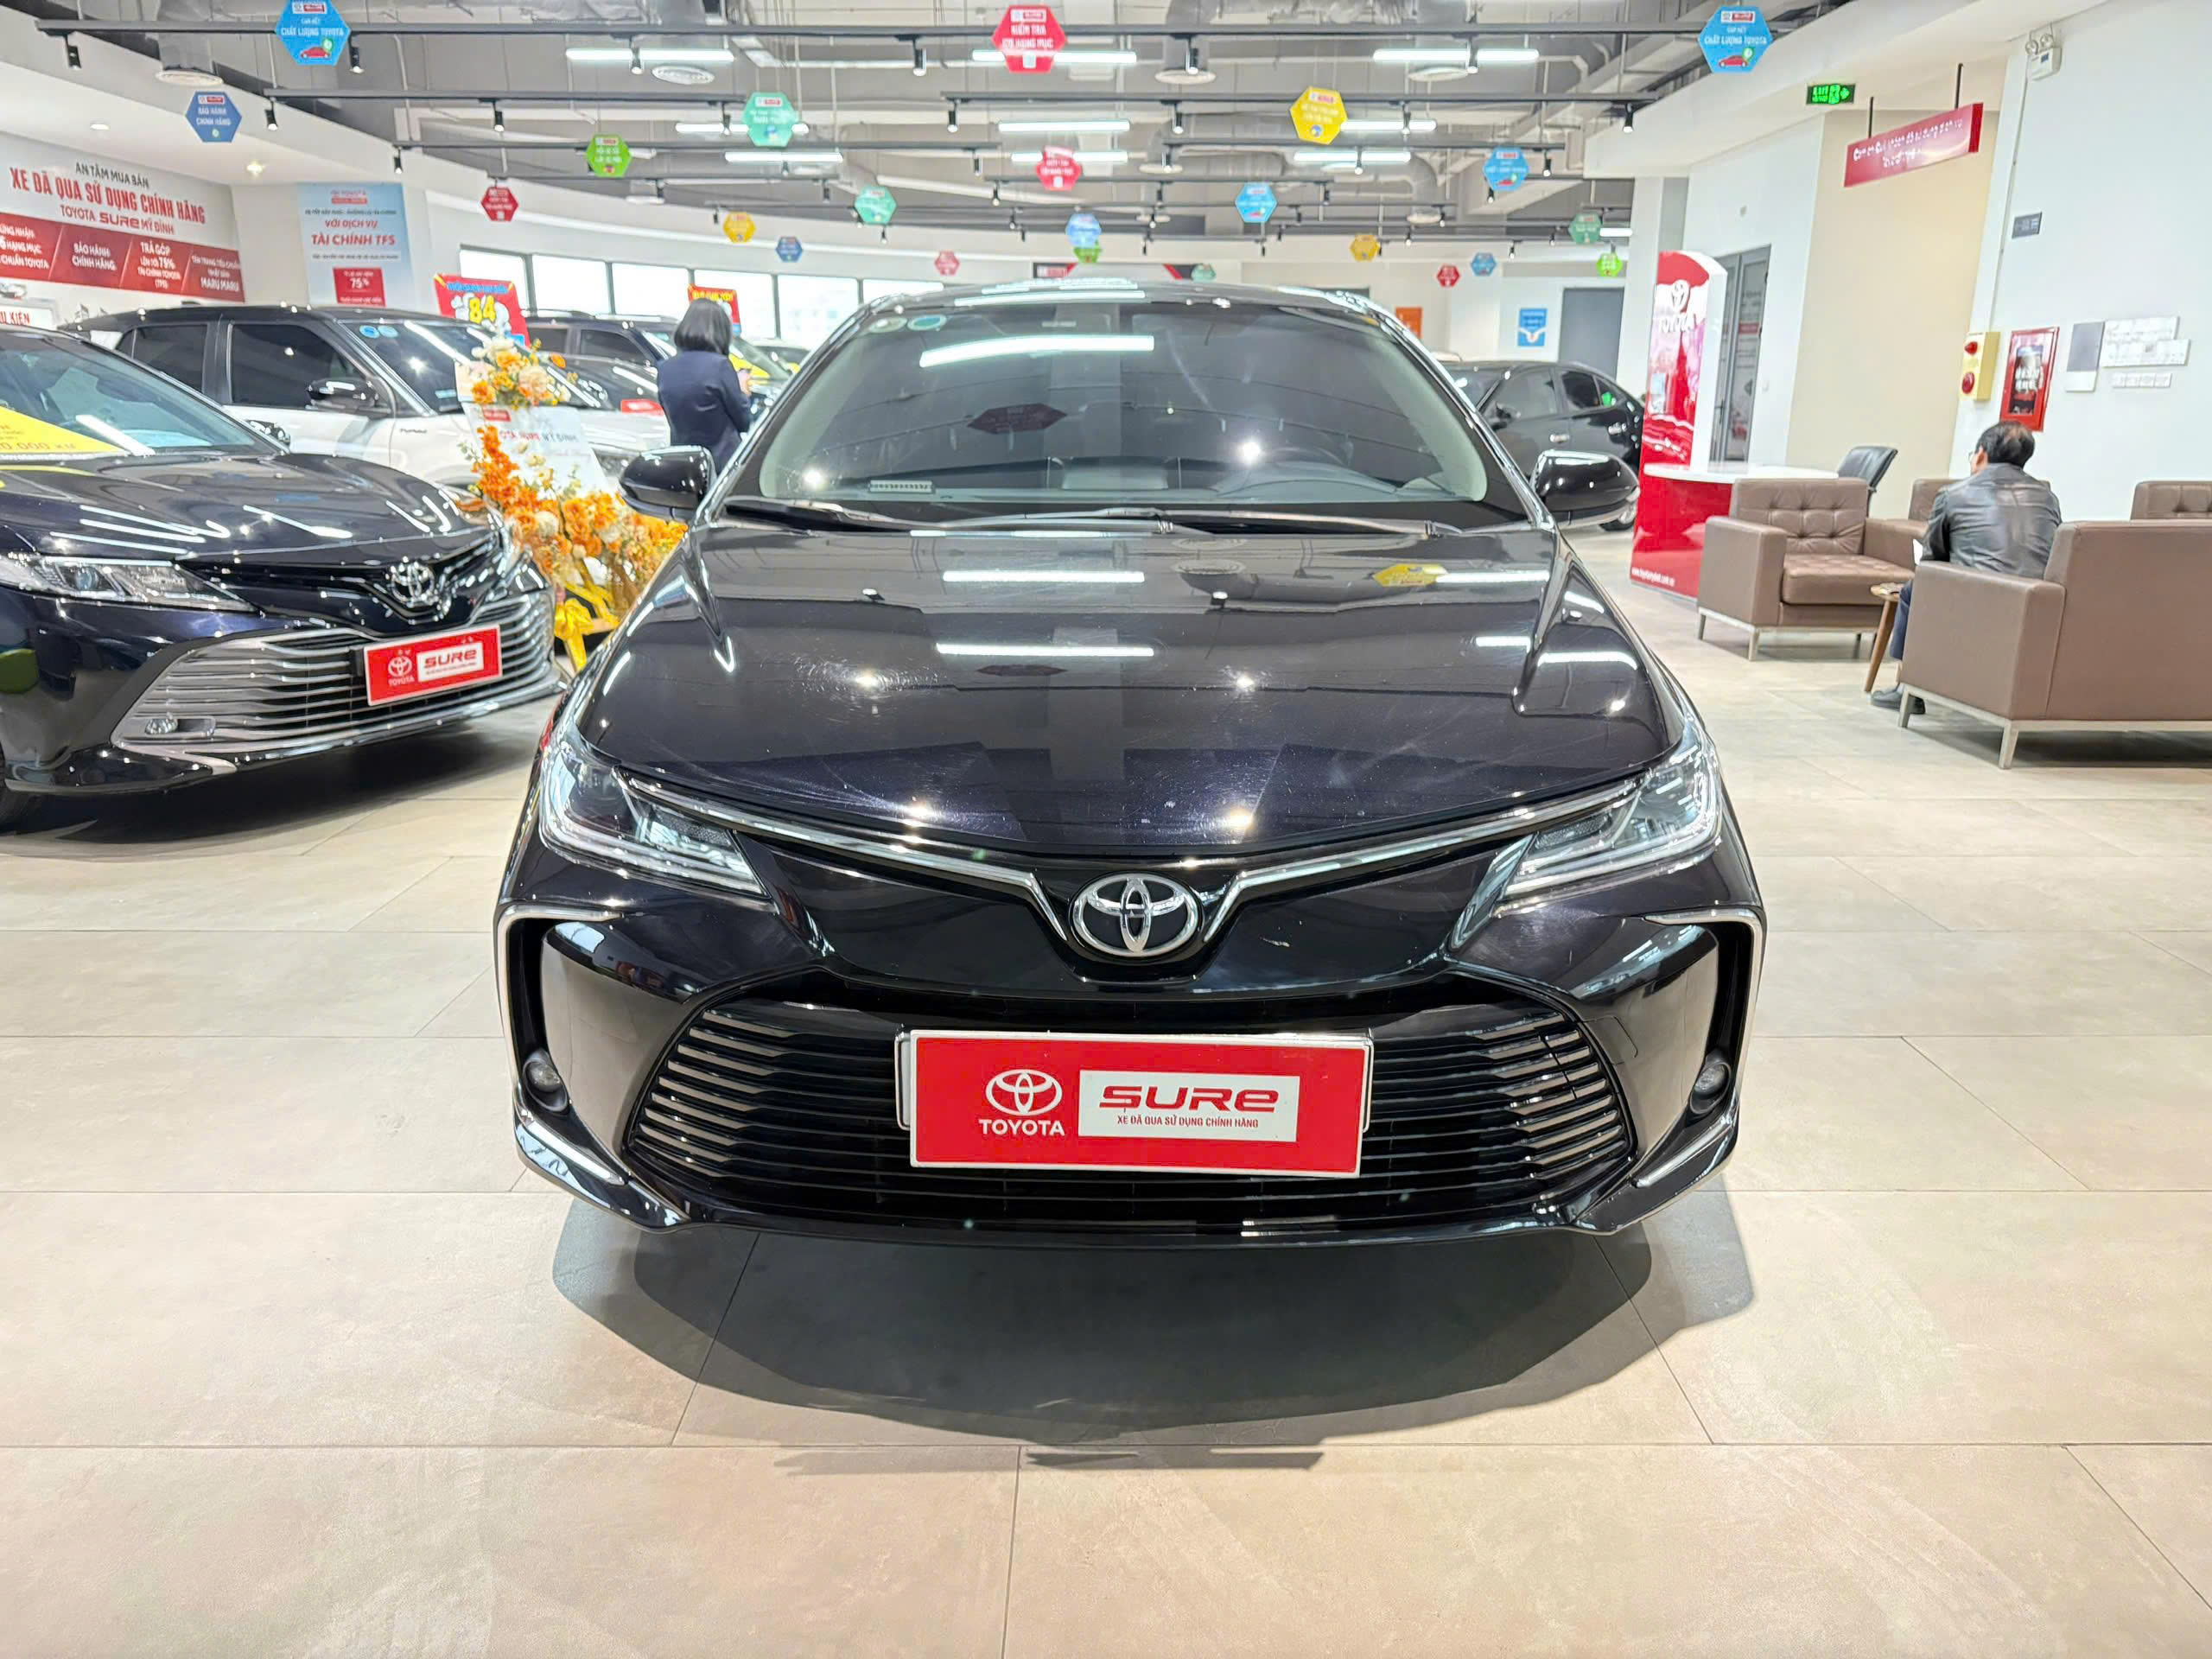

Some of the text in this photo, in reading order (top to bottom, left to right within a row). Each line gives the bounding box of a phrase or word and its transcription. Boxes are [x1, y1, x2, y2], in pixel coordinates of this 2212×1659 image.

[75, 162, 88, 175] AN
[111, 169, 130, 184] MUA
[10, 166, 29, 191] XE
[32, 170, 52, 195] ĐÃ
[54, 176, 82, 200] QUA
[85, 179, 102, 205] SỬ
[105, 186, 137, 211] DỤNG
[140, 192, 174, 218] CHÍNH
[60, 204, 96, 221] TOYOTA
[312, 232, 329, 245] TÀI
[332, 231, 372, 245] CHÍNH
[389, 675, 415, 687] TOYOTA
[978, 1118, 1065, 1136] TOYOTA
[1117, 1115, 1128, 1125] XE
[1144, 1116, 1162, 1126] QUA
[1179, 1116, 1204, 1128] DỤNG
[1205, 1116, 1232, 1128] CHÍNH
